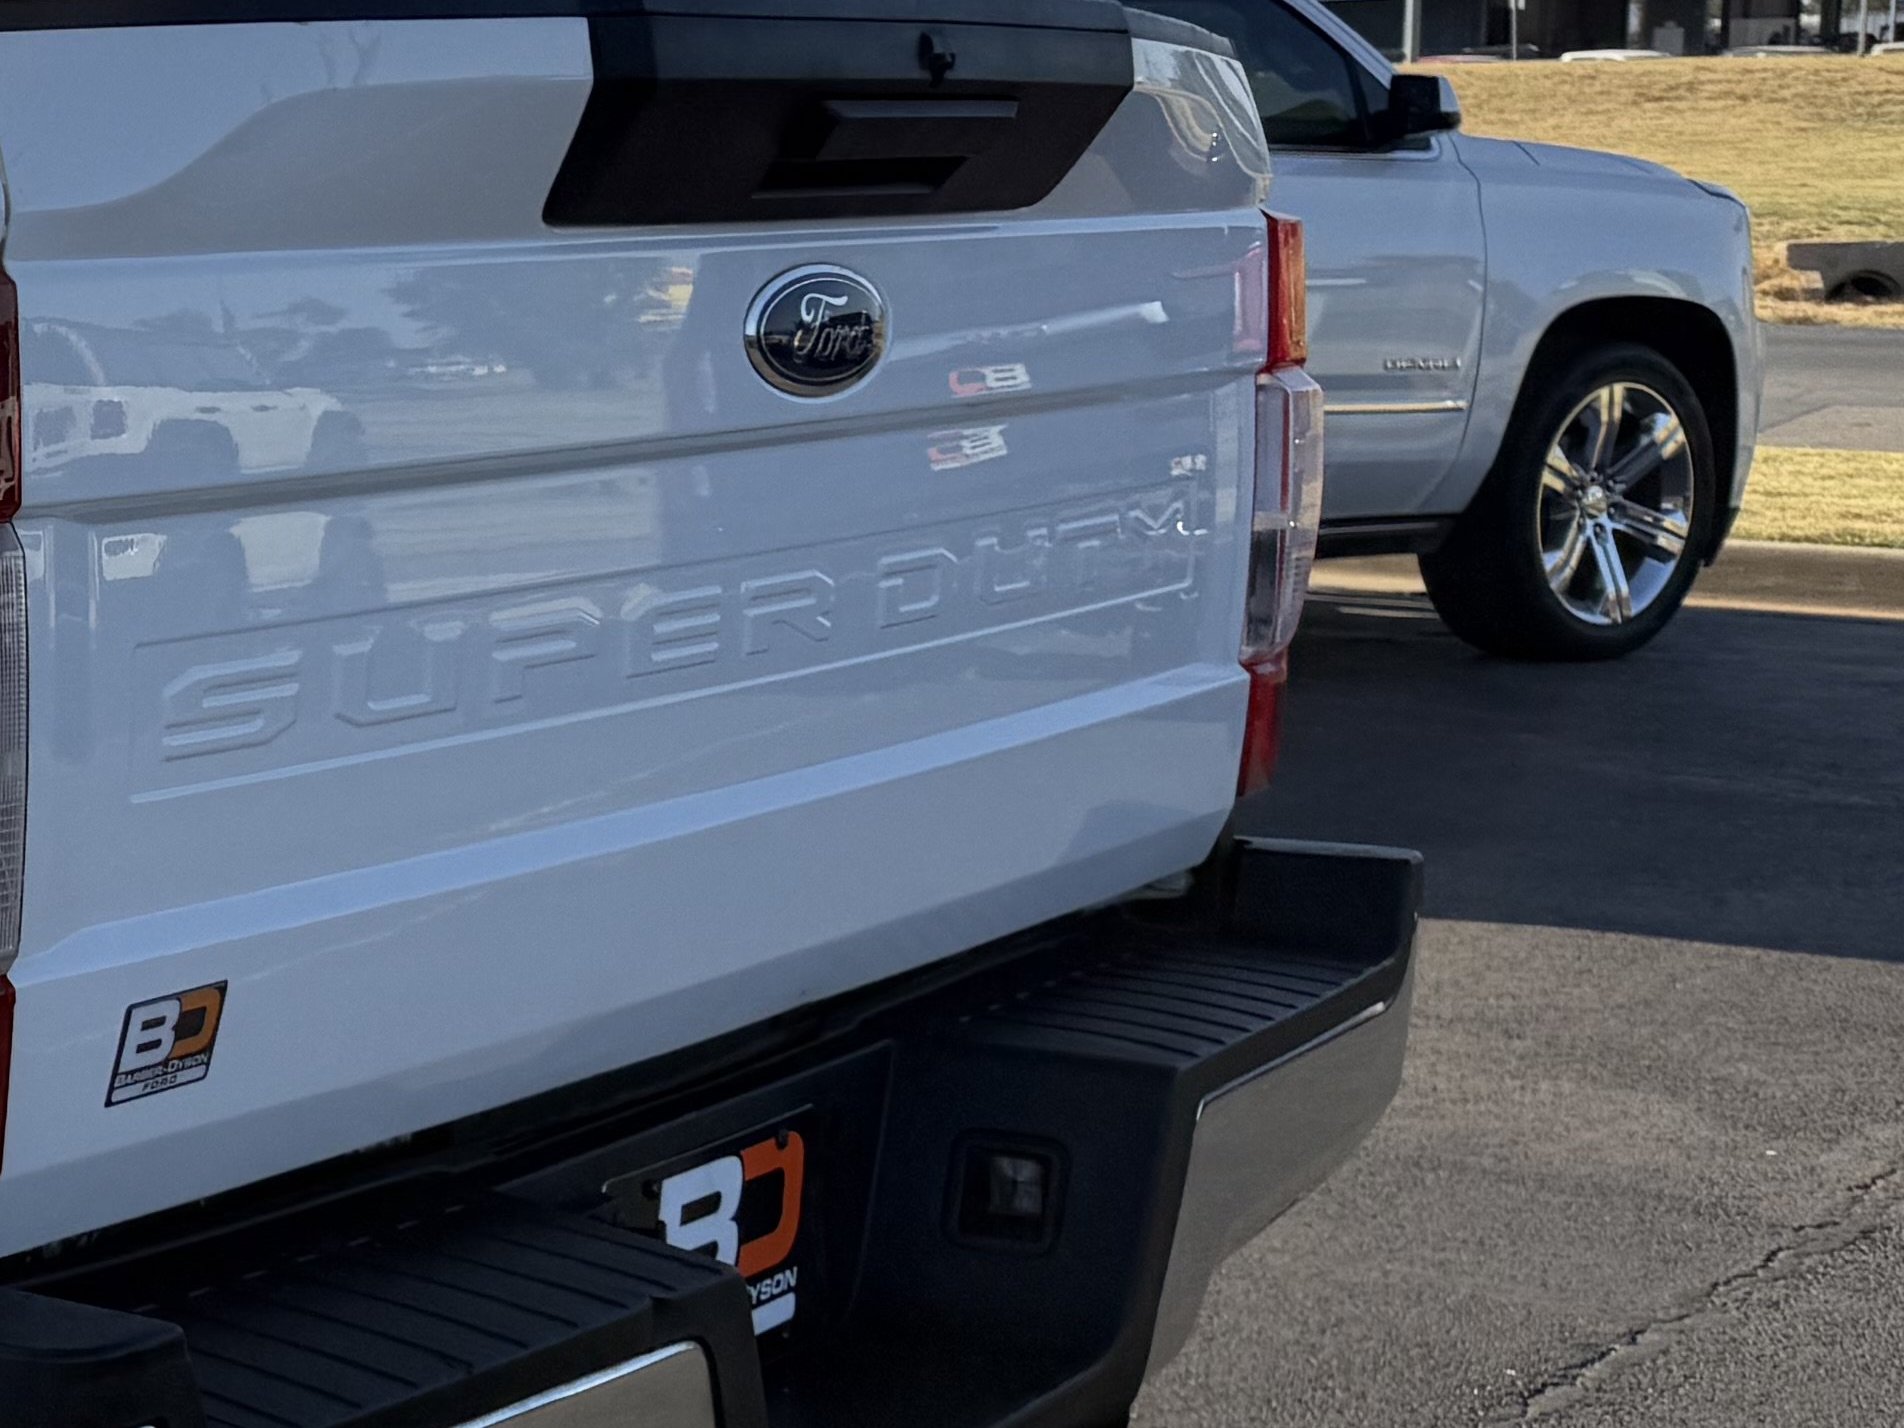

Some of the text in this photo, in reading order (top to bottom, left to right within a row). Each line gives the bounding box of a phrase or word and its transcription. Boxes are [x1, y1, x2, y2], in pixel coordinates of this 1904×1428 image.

[793, 292, 876, 362] Ford
[162, 568, 836, 763] SUPER
[744, 1265, 798, 1305] YSON
